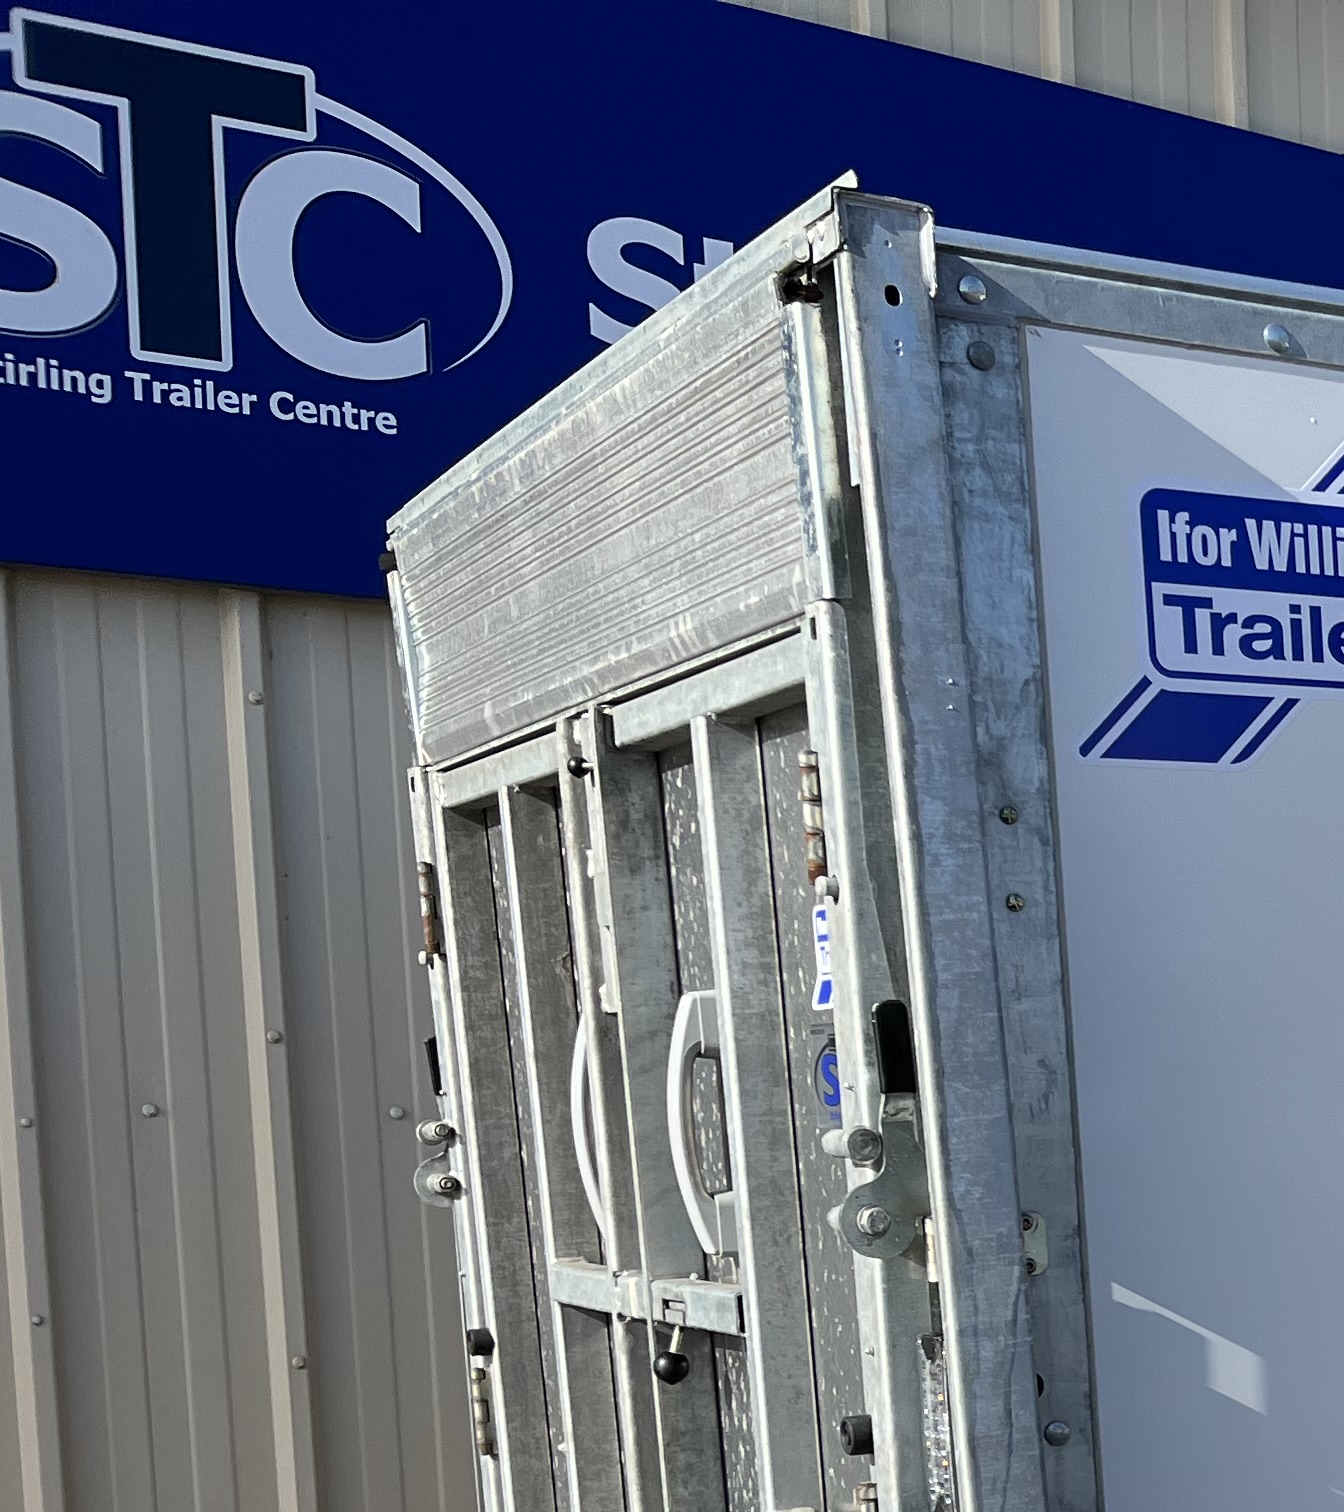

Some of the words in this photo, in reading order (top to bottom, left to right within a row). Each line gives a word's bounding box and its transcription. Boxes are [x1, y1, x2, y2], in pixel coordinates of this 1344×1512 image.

[0, 353, 113, 404] irling
[124, 370, 257, 415] Trailer
[269, 391, 398, 435] Centre
[1156, 508, 1237, 567] Ifor
